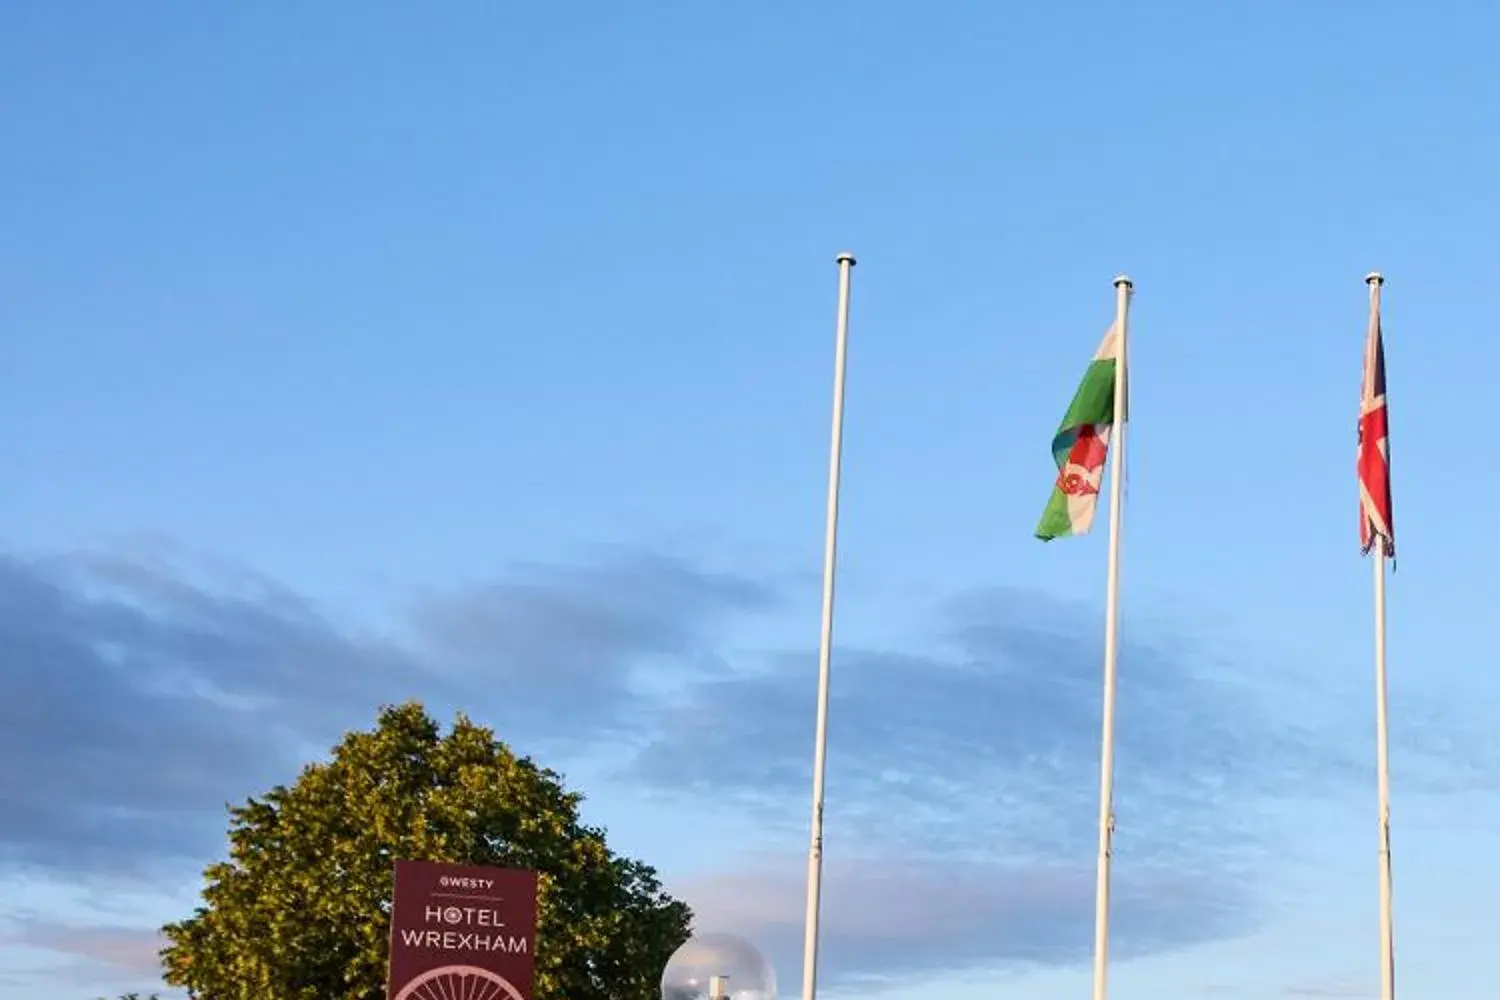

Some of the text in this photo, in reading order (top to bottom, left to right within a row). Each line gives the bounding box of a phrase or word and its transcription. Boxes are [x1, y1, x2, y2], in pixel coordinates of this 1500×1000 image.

[440, 876, 494, 889] GWESTY
[425, 905, 505, 927] HOTEL
[401, 929, 528, 953] WREXHAM
